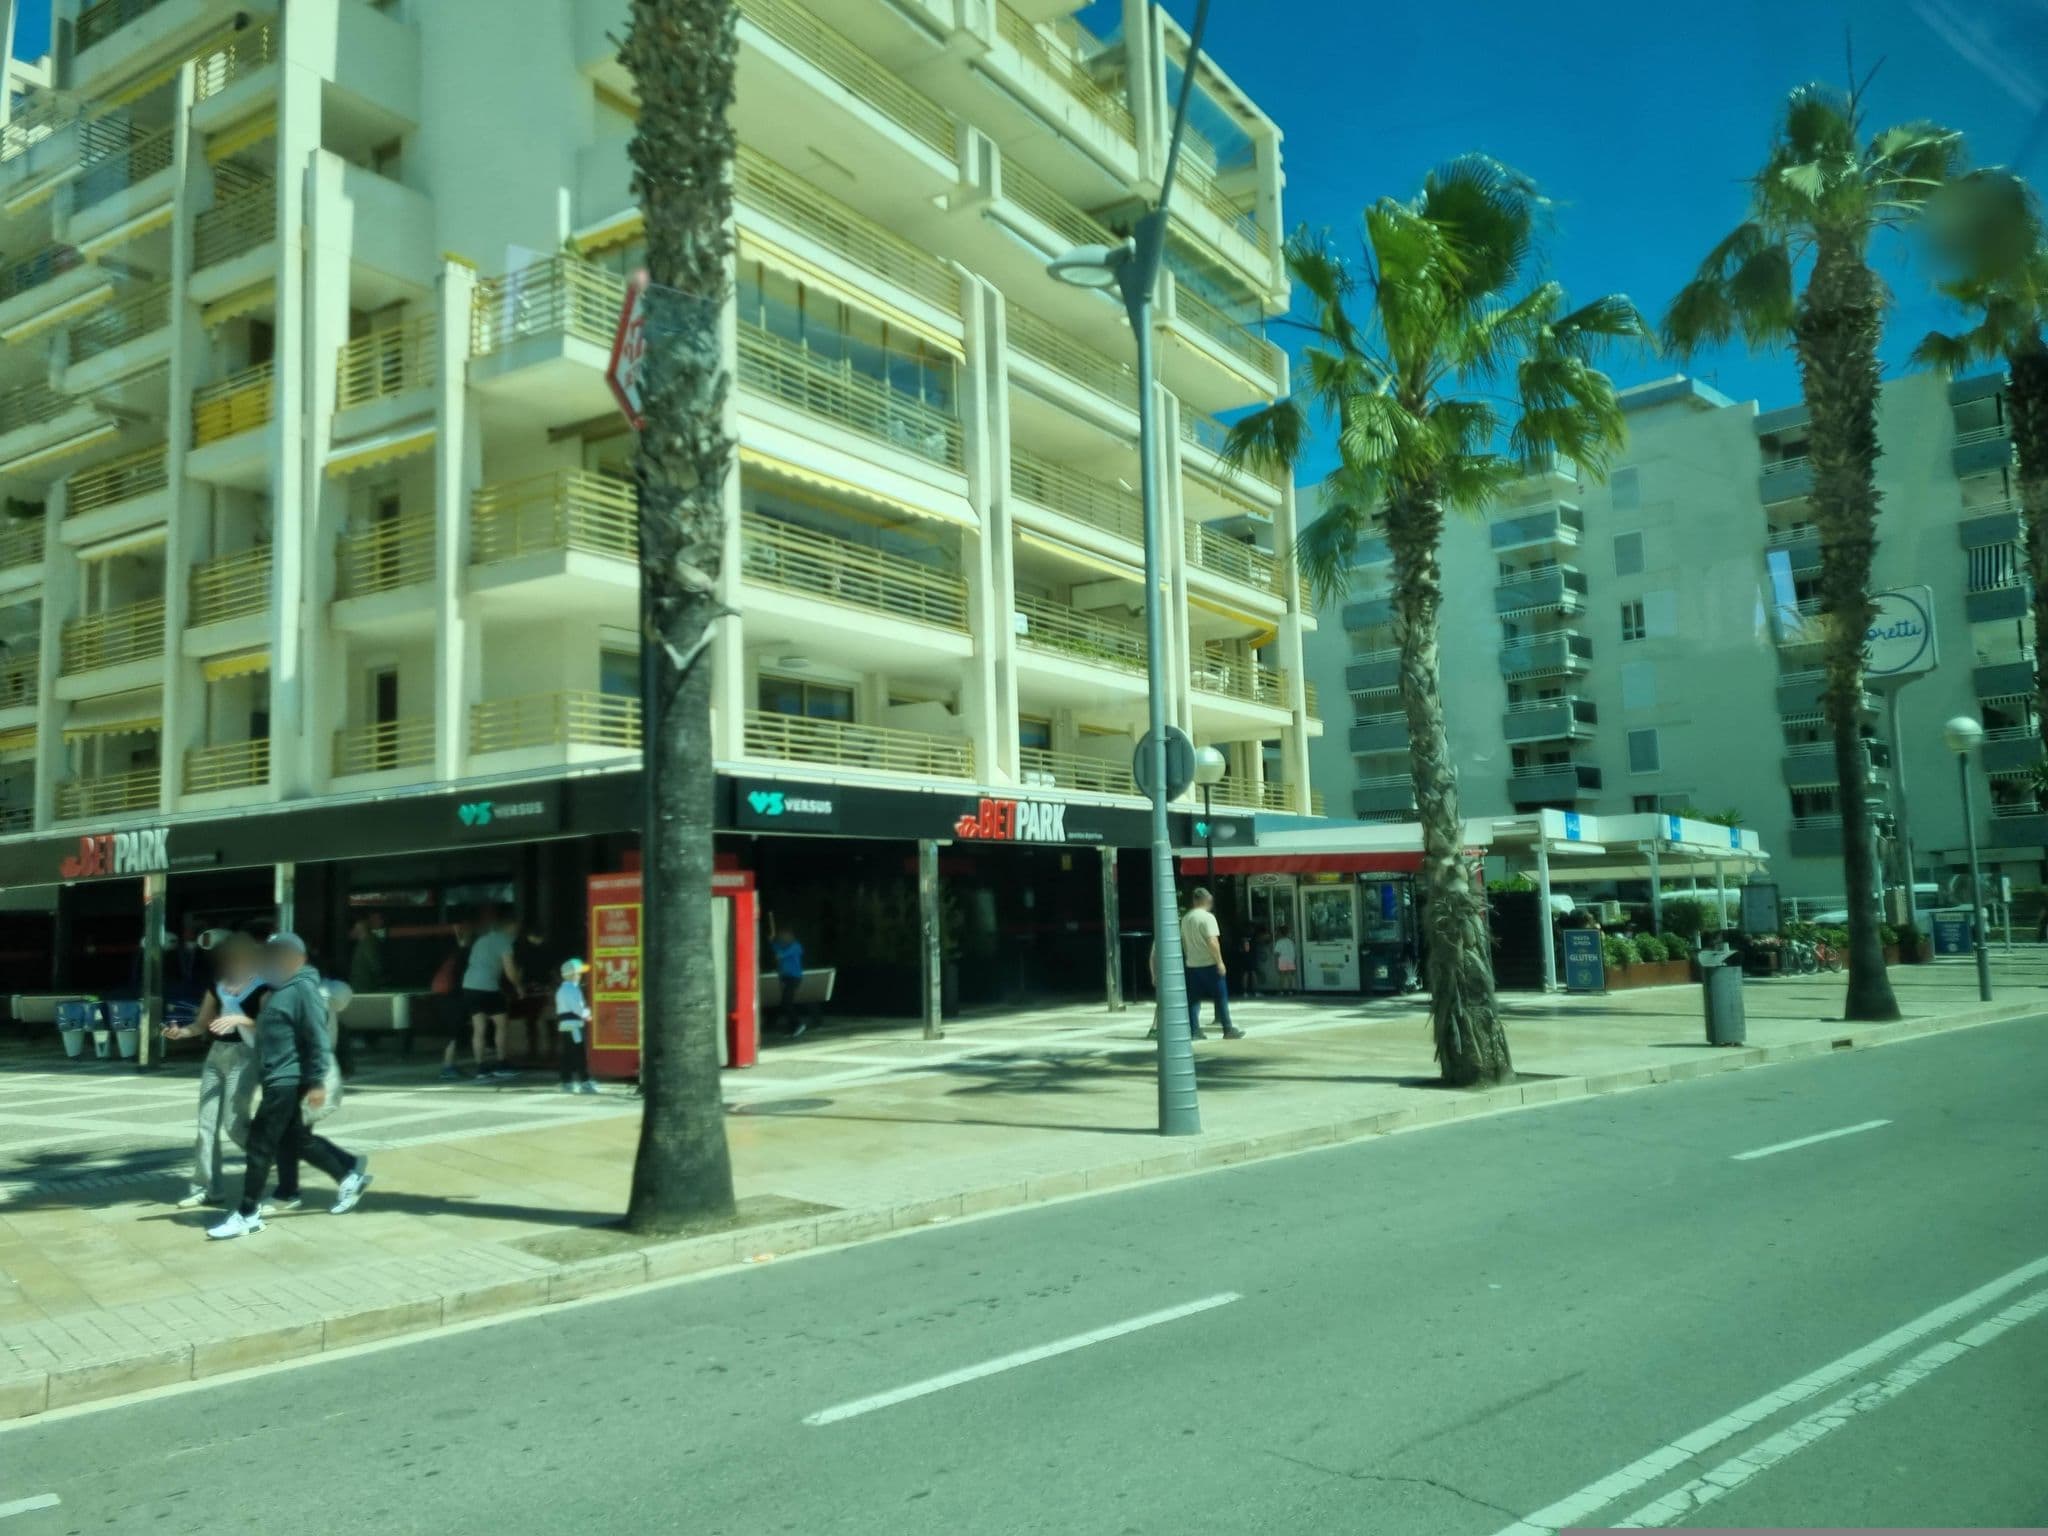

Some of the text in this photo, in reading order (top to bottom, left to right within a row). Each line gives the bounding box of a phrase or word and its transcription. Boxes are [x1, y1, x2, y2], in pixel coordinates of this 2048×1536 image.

[1865, 620, 1922, 640] oretti
[784, 798, 832, 815] VERSUS
[979, 799, 1066, 842] BETPARK
